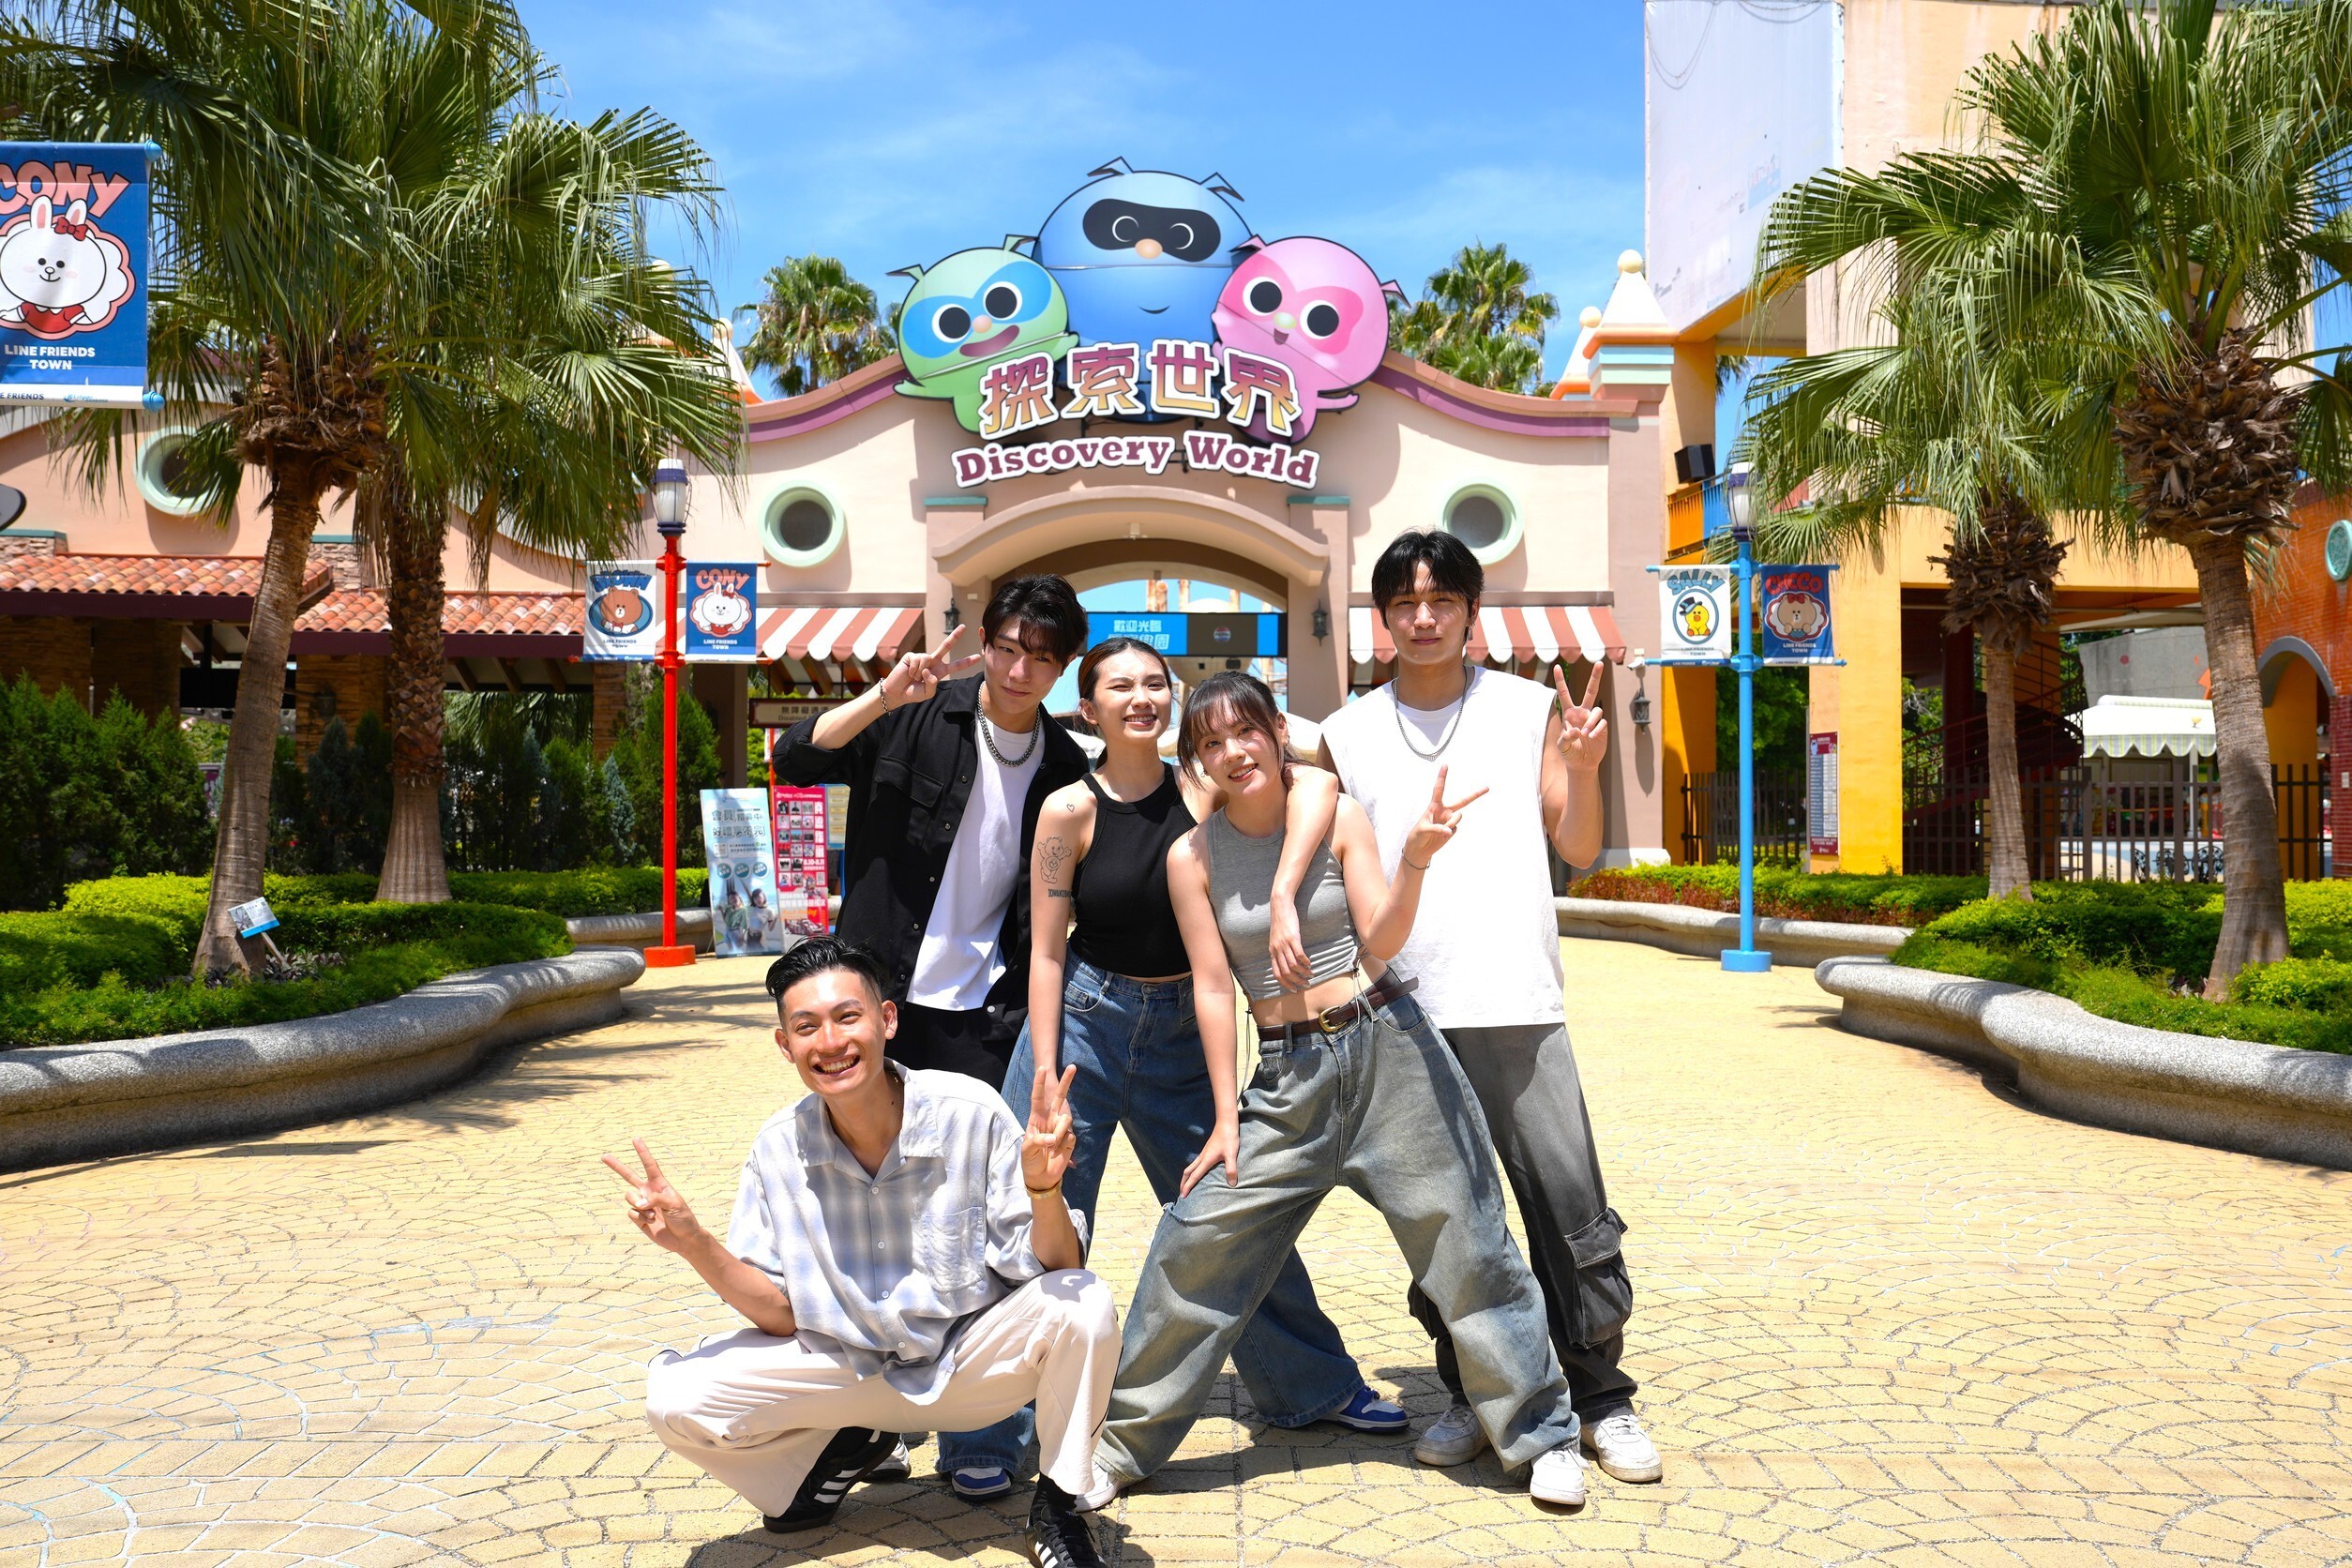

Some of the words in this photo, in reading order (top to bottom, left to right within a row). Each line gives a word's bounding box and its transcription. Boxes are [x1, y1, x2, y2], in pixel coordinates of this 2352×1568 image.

[0, 159, 131, 219] CONY
[4, 344, 38, 356] LINE
[39, 346, 96, 357] FRIENDS
[29, 359, 72, 370] TOWN
[7, 392, 44, 400] FRIENDS
[983, 342, 1298, 435] 探索世界
[956, 438, 1171, 483] Discovery
[1186, 434, 1316, 484] World
[695, 567, 750, 591] CONY
[1667, 568, 1726, 596] SALLY
